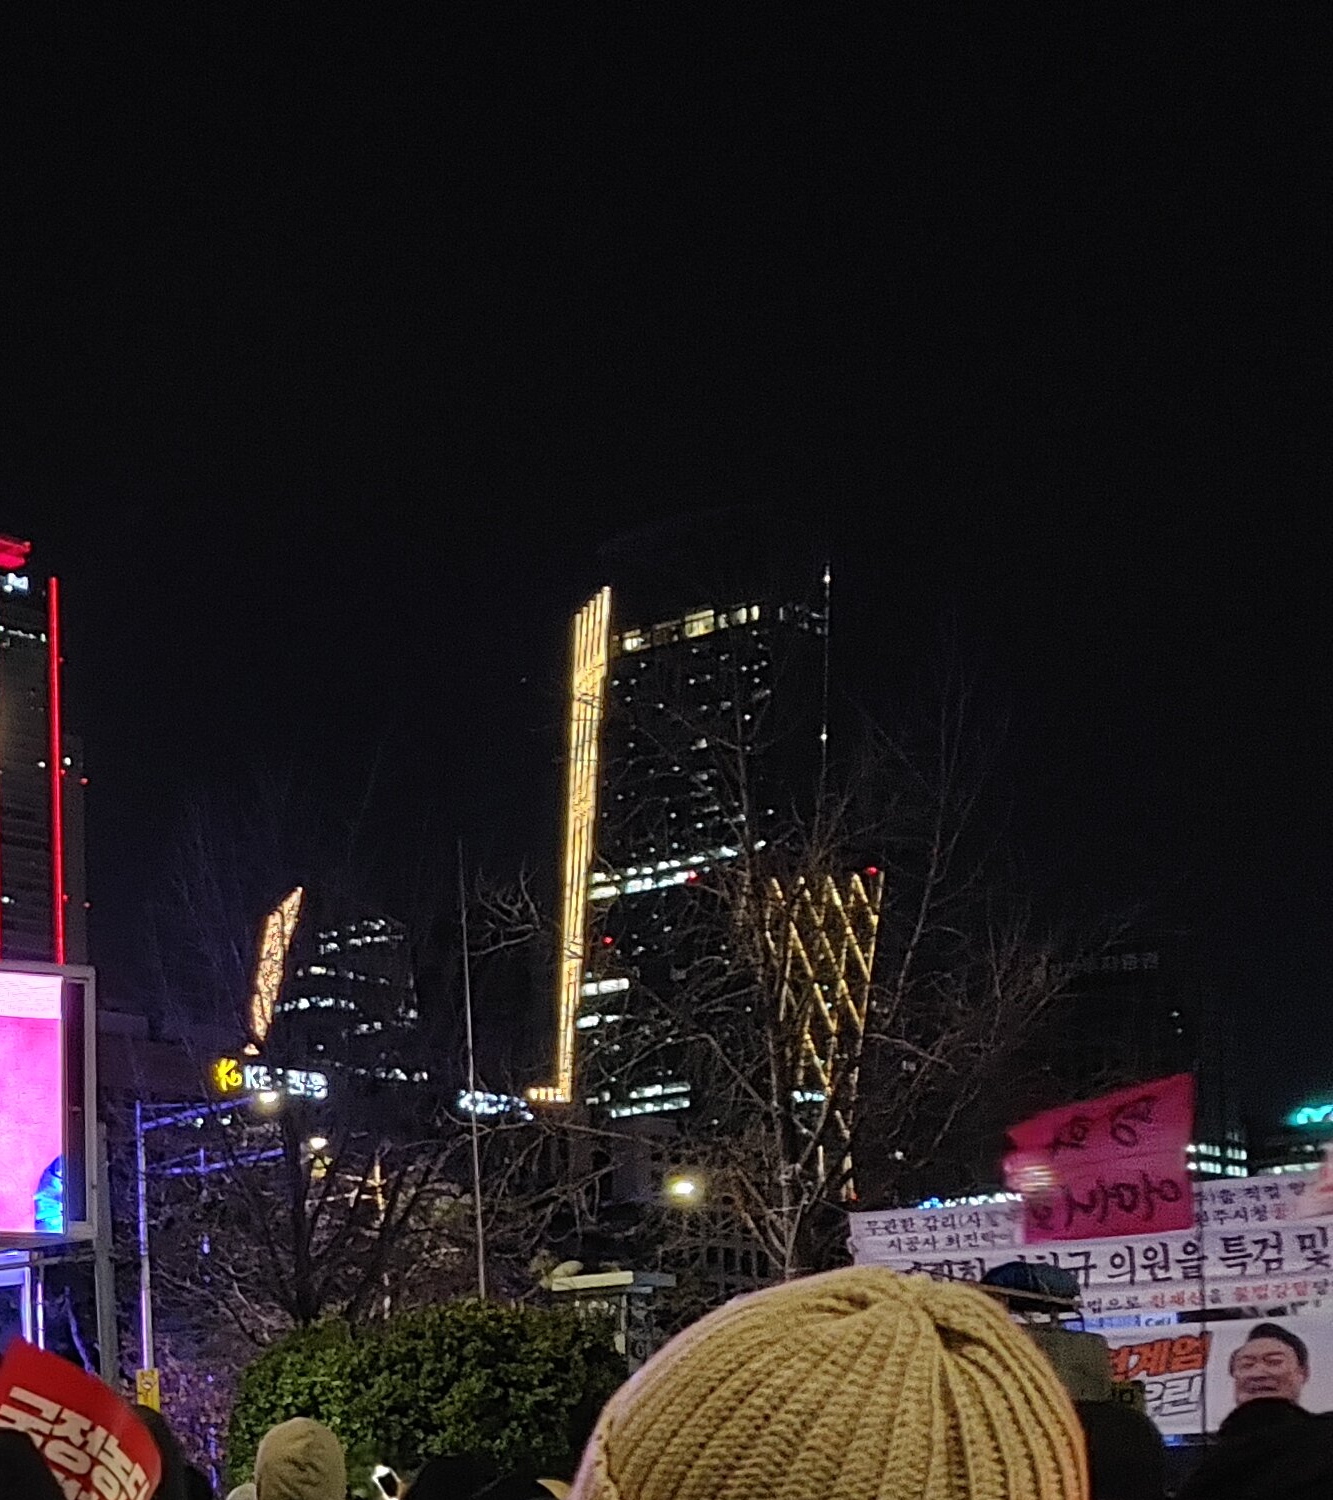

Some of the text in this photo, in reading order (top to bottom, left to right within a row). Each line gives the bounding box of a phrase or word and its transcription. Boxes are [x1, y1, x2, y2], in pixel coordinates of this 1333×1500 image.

[1107, 1240, 1208, 1286] 의원을
[1219, 1230, 1283, 1275] 특검
[1295, 1226, 1332, 1271] 및
